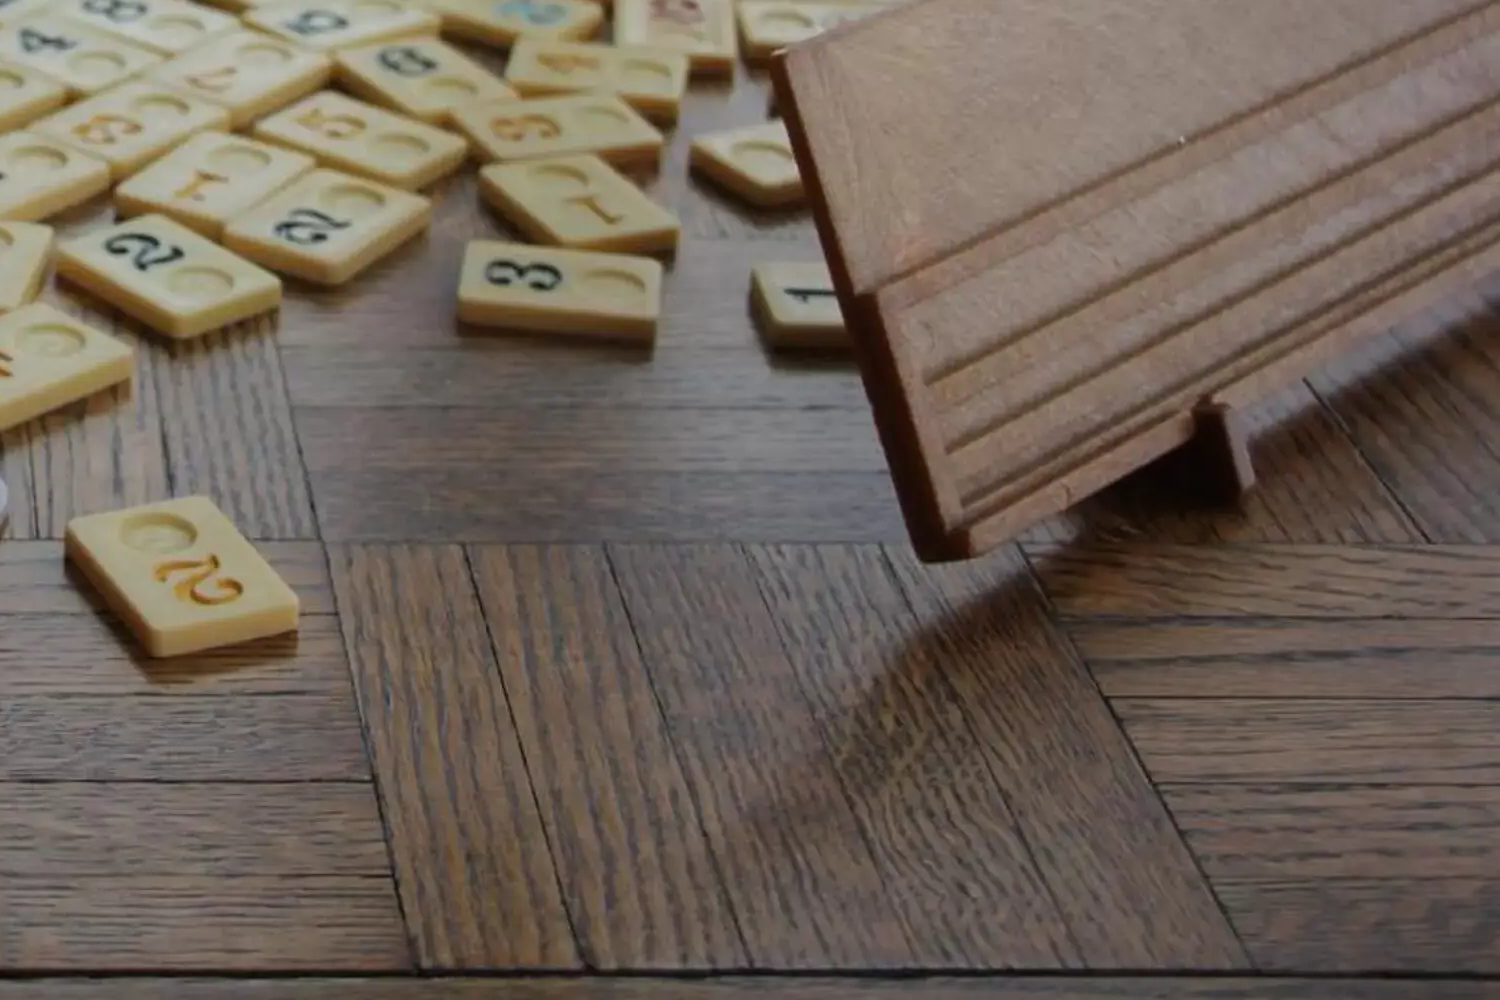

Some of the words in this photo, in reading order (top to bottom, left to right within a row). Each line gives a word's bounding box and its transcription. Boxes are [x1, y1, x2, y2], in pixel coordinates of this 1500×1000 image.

[18, 27, 78, 53] 4
[71, 113, 143, 145] 3
[296, 107, 367, 139] 5
[490, 113, 562, 141] 3
[174, 168, 229, 202] 1
[273, 207, 352, 245] 2
[564, 195, 622, 225] 1
[104, 232, 185, 271] 2
[485, 259, 562, 292] 3
[154, 553, 244, 605] 2
